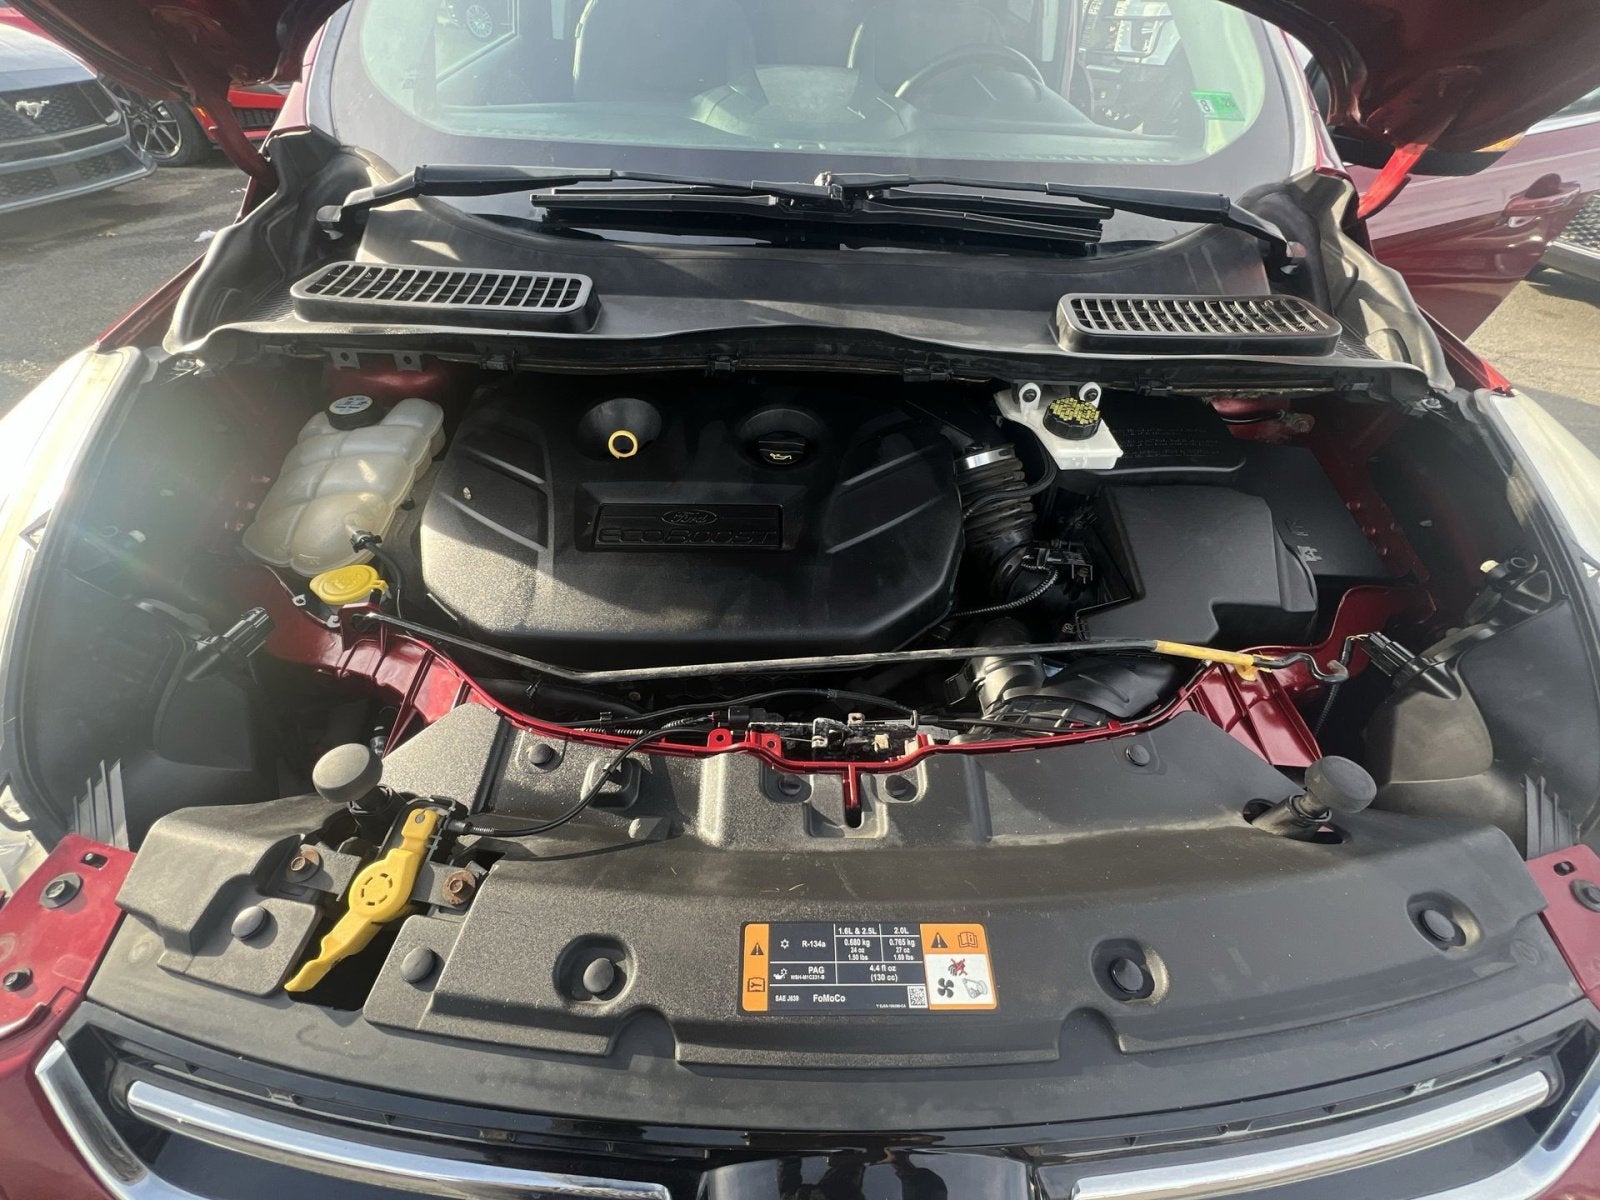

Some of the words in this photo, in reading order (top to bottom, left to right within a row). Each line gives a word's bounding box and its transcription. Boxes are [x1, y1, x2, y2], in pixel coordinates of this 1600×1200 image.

[838, 927, 853, 935] 1.6L
[854, 927, 861, 935] &
[862, 927, 877, 935] 2.5L
[893, 927, 909, 935] 2.0L
[801, 940, 826, 948] R-134a
[861, 938, 871, 948] kg
[906, 938, 916, 948] kg
[808, 966, 825, 974] PAG
[870, 973, 885, 982] (130
[886, 973, 898, 982] cc)
[812, 994, 846, 1003] FoMoCo
